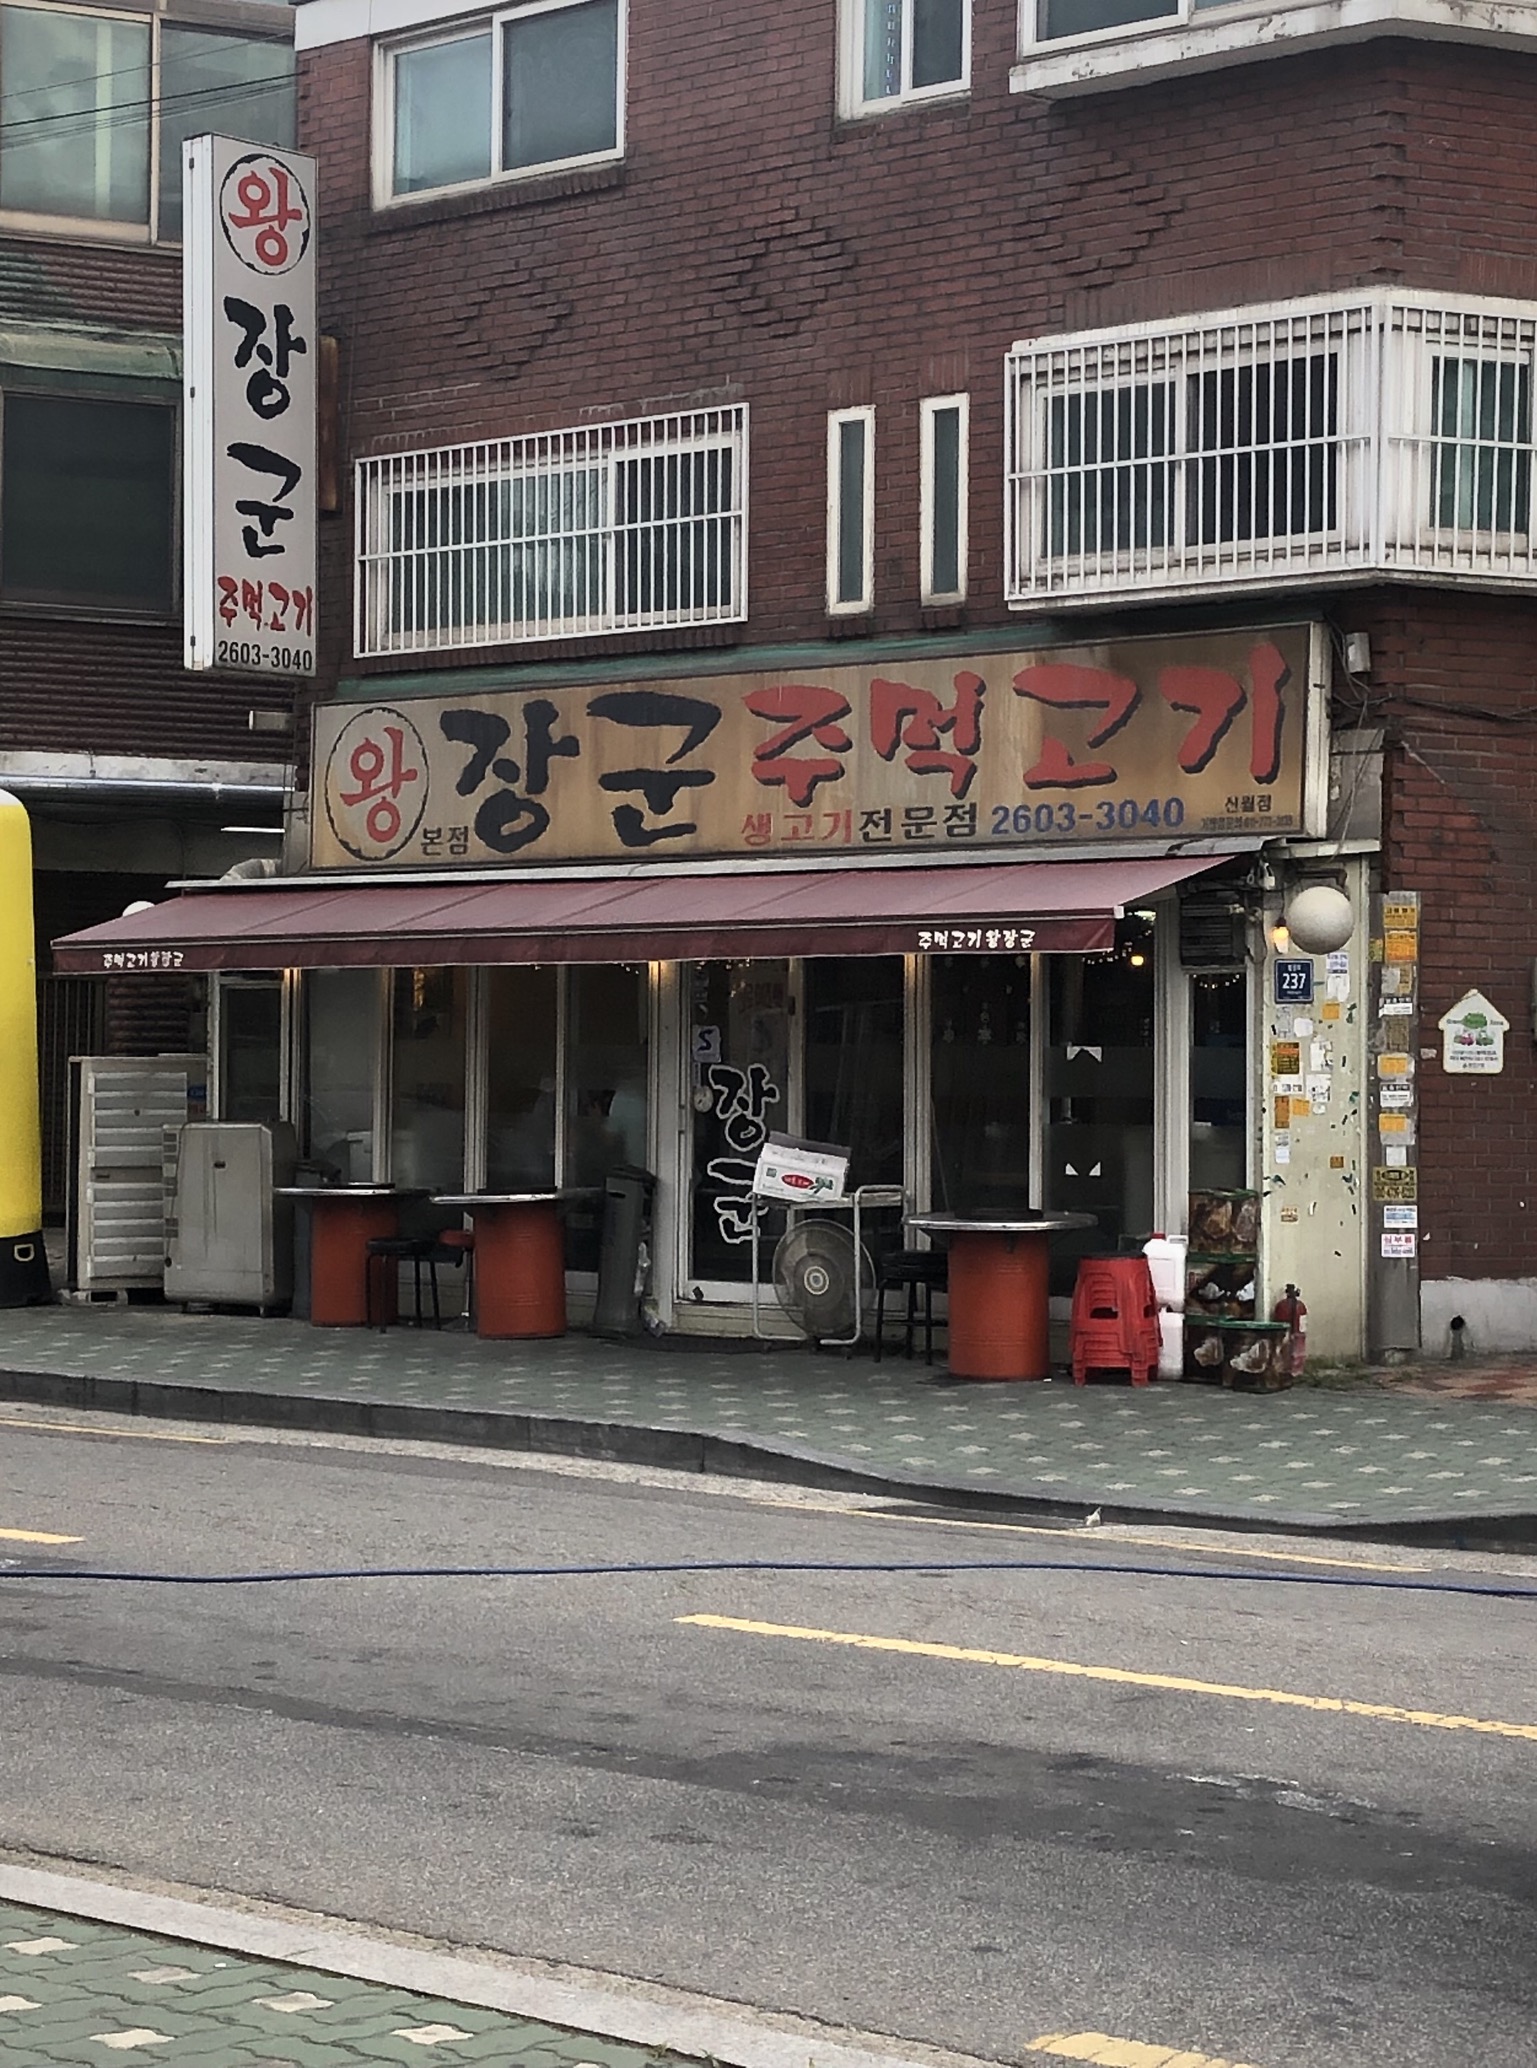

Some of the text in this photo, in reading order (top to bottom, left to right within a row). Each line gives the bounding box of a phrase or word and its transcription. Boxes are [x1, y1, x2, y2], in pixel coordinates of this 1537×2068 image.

[229, 167, 303, 267] 왕
[223, 296, 307, 559] 장군
[217, 575, 313, 637] 주먹고기
[218, 640, 313, 672] 2603-3040
[340, 642, 1292, 854] 왕 장군 주먹고기
[421, 826, 469, 857] 본점
[991, 797, 1185, 836] 2603-3040
[1282, 973, 1306, 990] 237
